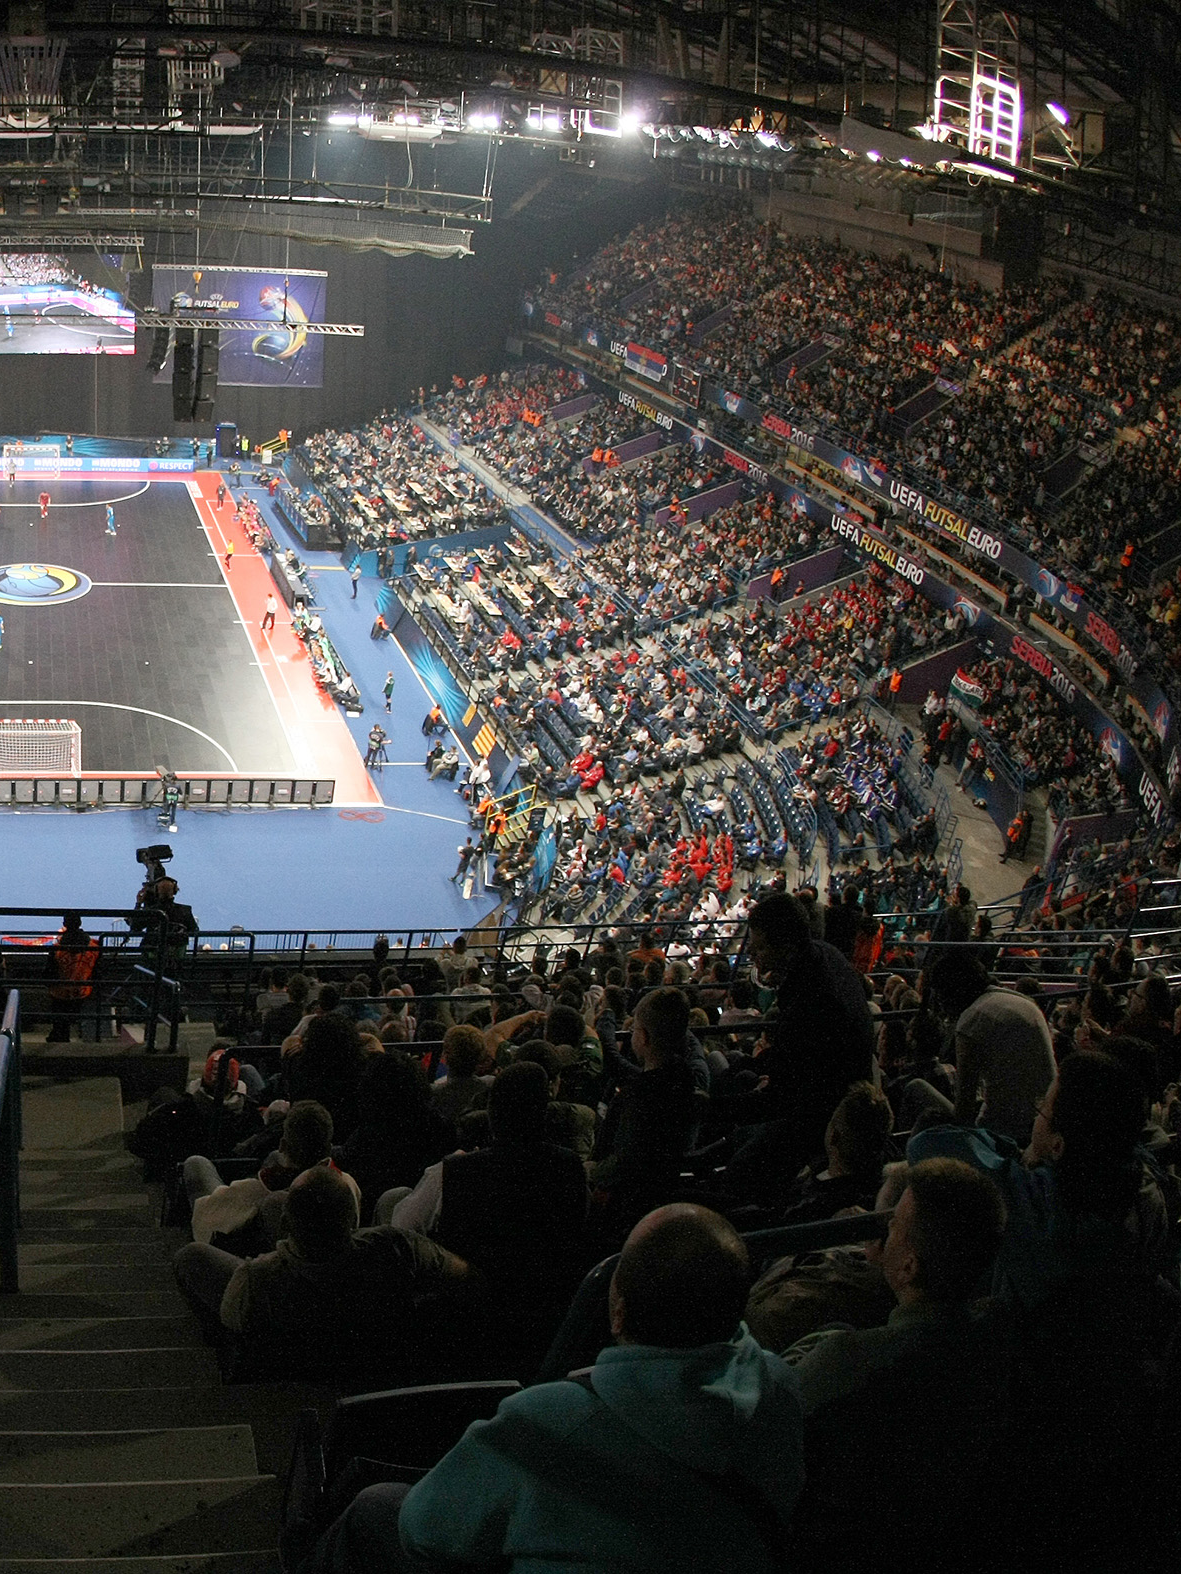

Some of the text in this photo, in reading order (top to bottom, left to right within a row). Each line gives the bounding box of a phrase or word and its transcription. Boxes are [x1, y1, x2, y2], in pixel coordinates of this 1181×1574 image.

[619, 390, 637, 410] UEFA
[761, 414, 815, 450] SERBIA 2016
[724, 450, 769, 487] SERBIA 2016
[889, 480, 924, 515] UEFA
[831, 514, 860, 545] UEFA
[1084, 611, 1121, 657] SERBIA
[1010, 635, 1076, 703] SERBIA 2016
